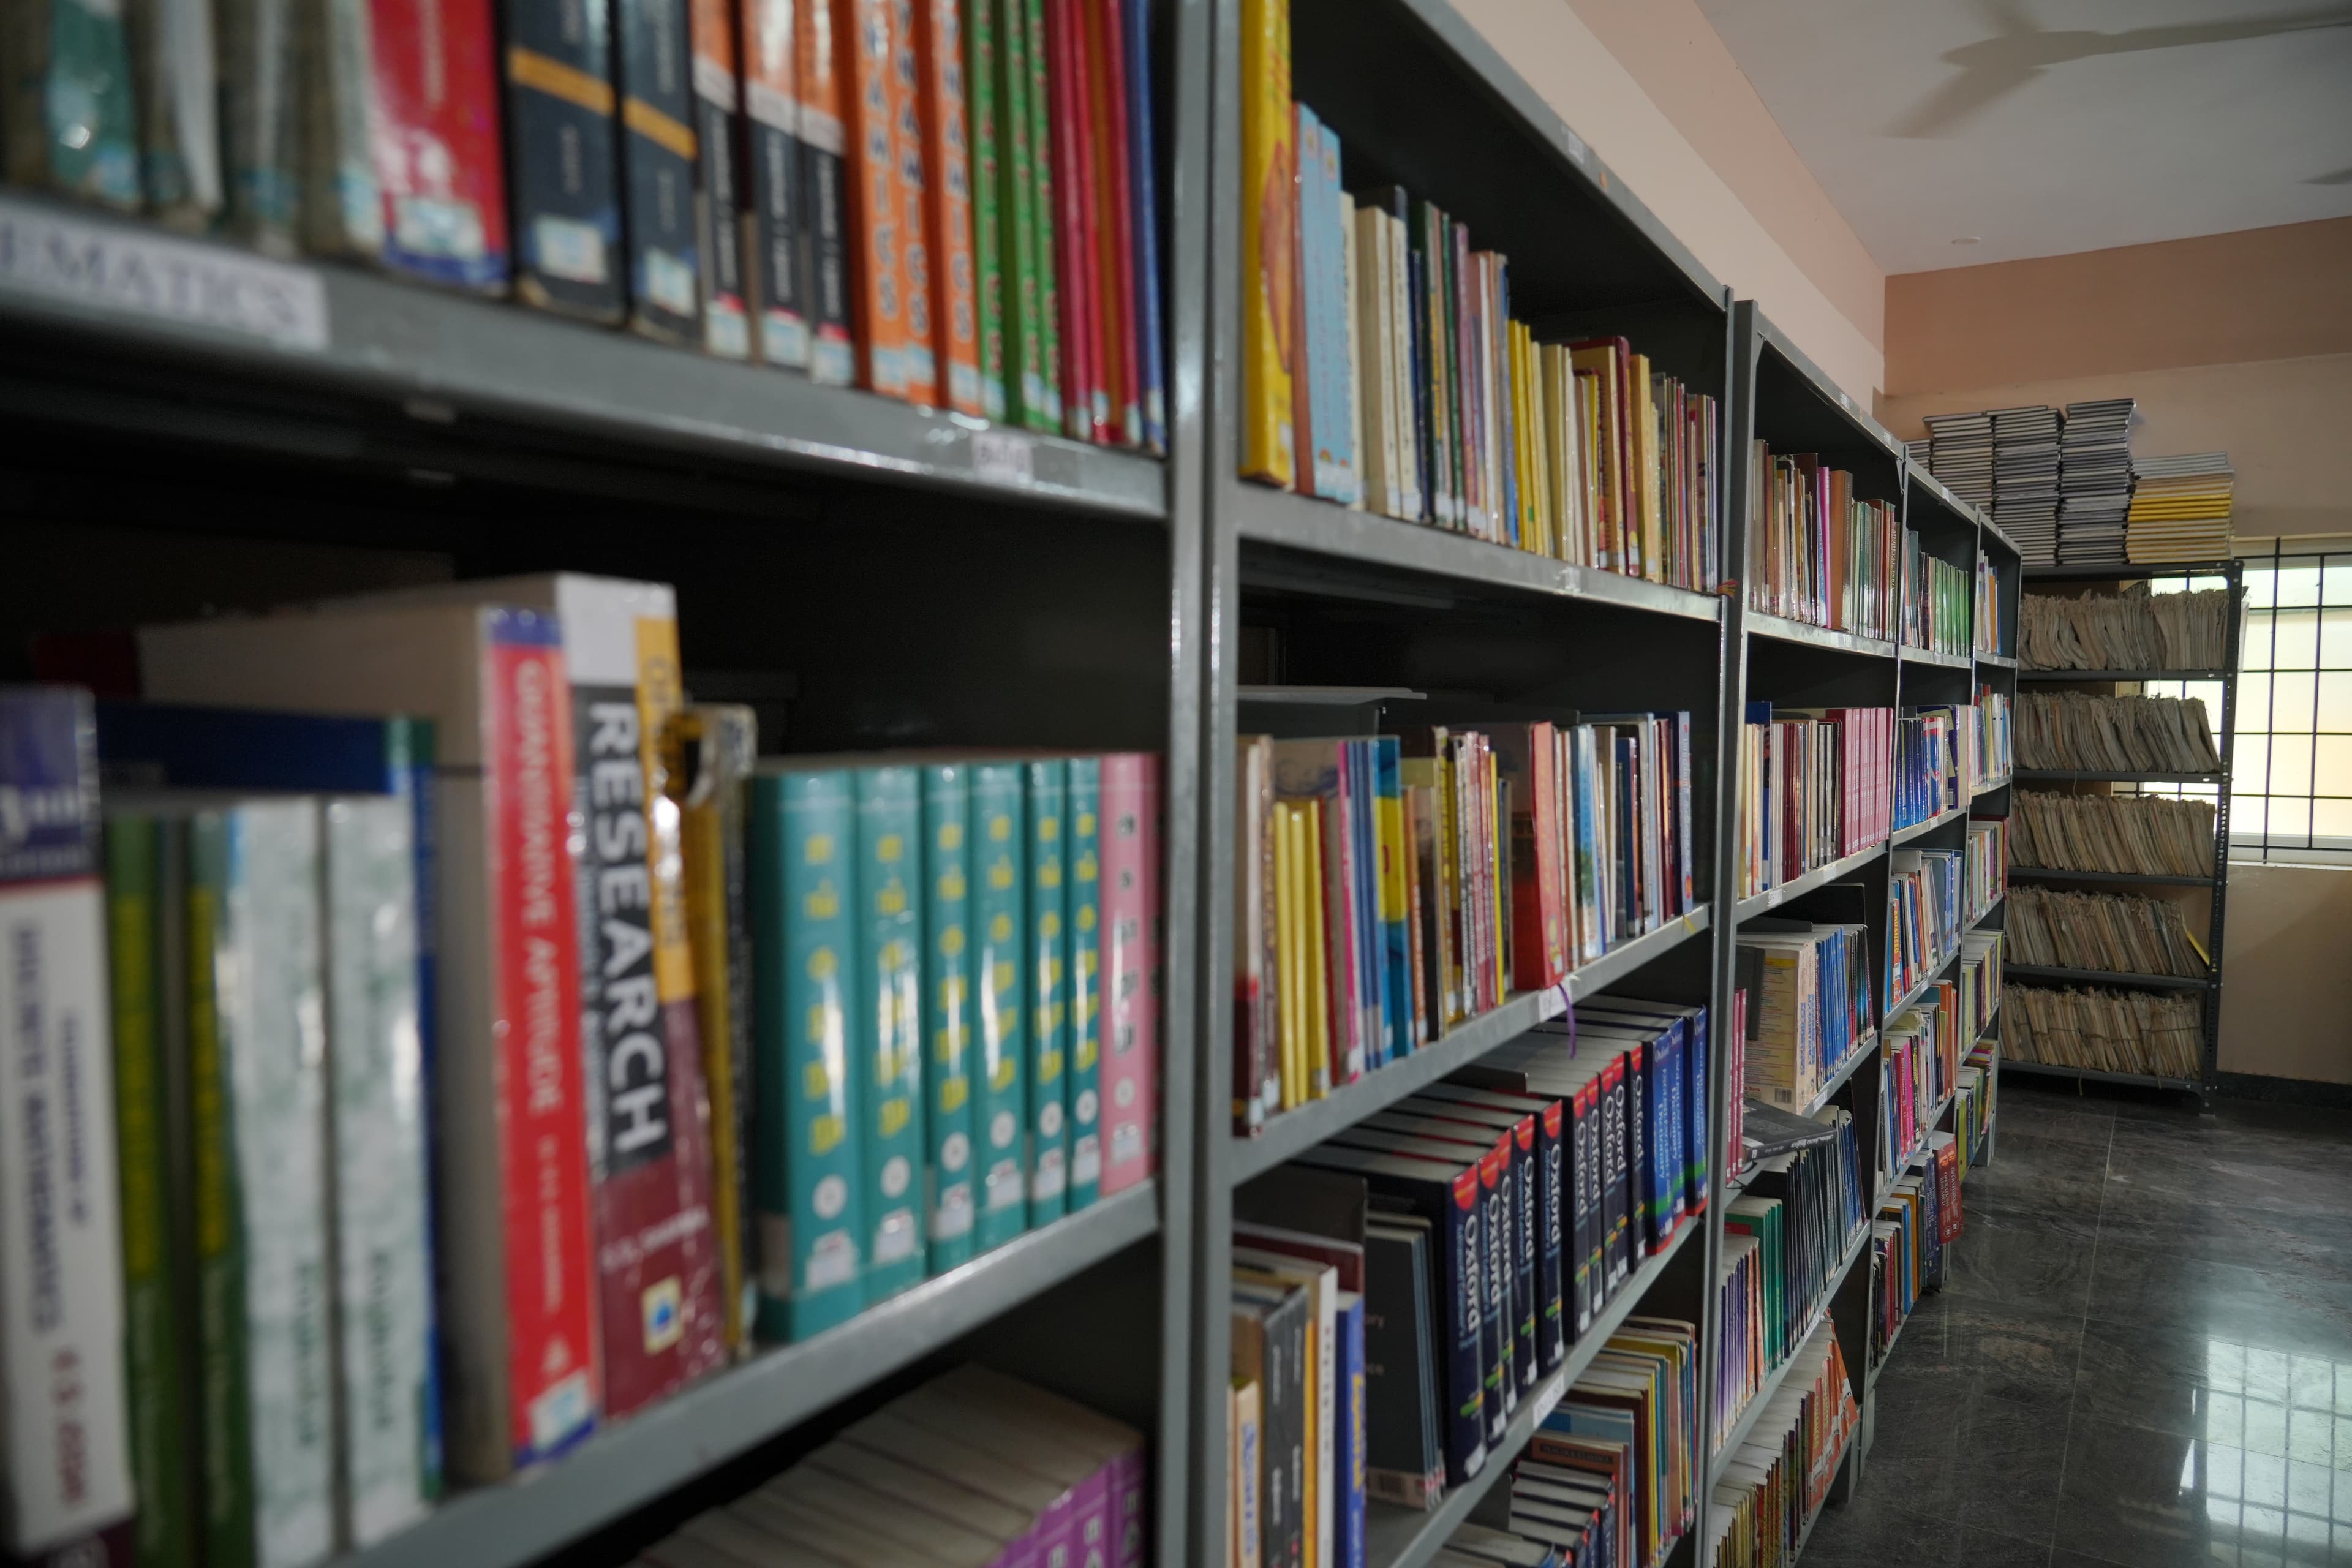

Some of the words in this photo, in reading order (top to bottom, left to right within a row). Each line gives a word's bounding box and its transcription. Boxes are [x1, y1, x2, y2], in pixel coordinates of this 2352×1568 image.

[587, 700, 669, 1155] RESEARCH
[1591, 1108, 1600, 1202] Oxford
[1605, 1095, 1617, 1186] Oxford
[1615, 1084, 1627, 1172] Oxford
[1635, 1074, 1644, 1159] Oxford
[1524, 1155, 1535, 1260] Oxford
[1550, 1143, 1561, 1245] Oxford
[1578, 1121, 1588, 1217] Oxford
[1464, 1215, 1480, 1333] Oxford
[1488, 1193, 1501, 1306] Oxford
[1502, 1175, 1512, 1284] Oxford
